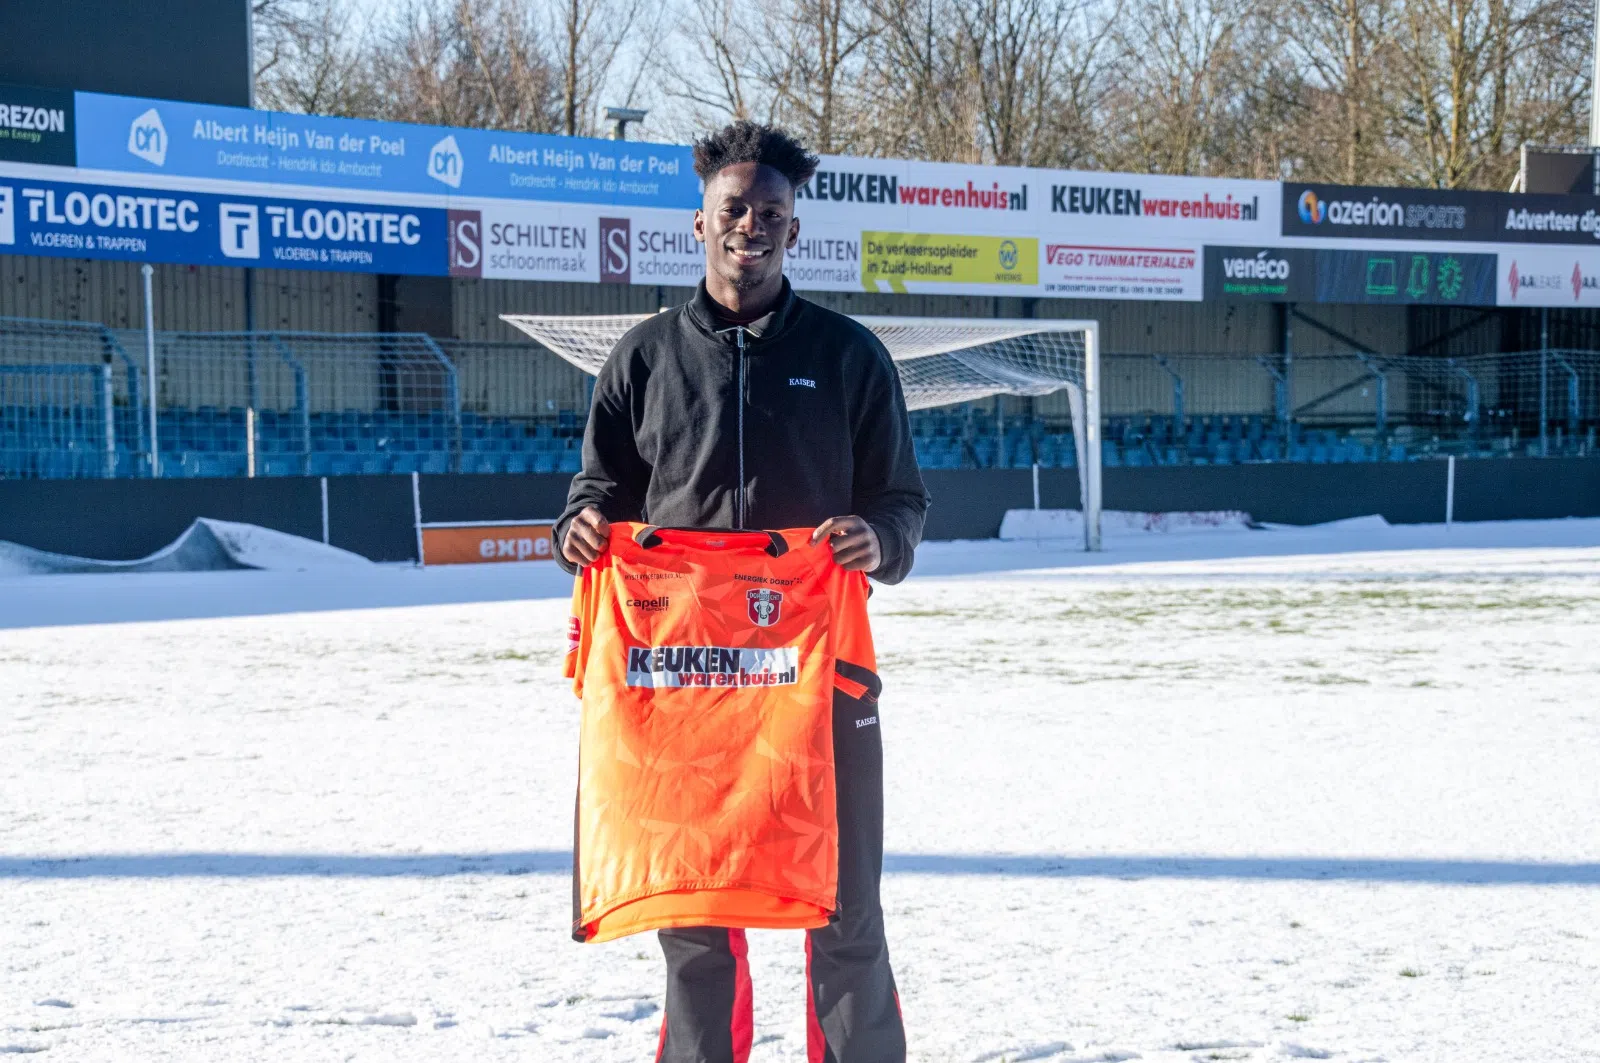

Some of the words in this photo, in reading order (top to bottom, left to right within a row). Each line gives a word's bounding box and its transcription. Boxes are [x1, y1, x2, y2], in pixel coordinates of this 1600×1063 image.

[11, 129, 42, 143] Energy
[192, 119, 249, 143] Albert
[253, 125, 299, 151] Heijn
[304, 130, 335, 150] Van
[338, 132, 366, 153] der
[370, 135, 405, 156] Poel
[217, 150, 269, 169] Dordrecht
[278, 156, 317, 173] Hendrik
[338, 160, 382, 178] Ambacht
[488, 144, 539, 166] Albert
[543, 148, 584, 172] Heijn
[588, 152, 616, 170] Van
[619, 154, 643, 173] der
[648, 157, 679, 176] Poel
[510, 173, 556, 189] Dordrecht
[564, 175, 600, 191] Hendrik
[618, 179, 659, 195] Ambacht
[22, 187, 200, 233] FLOORTEC
[1328, 197, 1403, 227] azerion
[1405, 204, 1466, 229] SPORTS
[1505, 208, 1579, 231] Adverteer
[265, 206, 420, 245] FLOORTEC
[490, 223, 587, 250] SCHILTEN
[30, 232, 83, 249] VLOEREN
[85, 235, 95, 250] &
[97, 235, 147, 252] TRAPPEN
[456, 220, 480, 268] S
[607, 228, 629, 275] S
[638, 231, 705, 255] SCHILT
[867, 241, 883, 255] De
[885, 241, 978, 261] verkeersopleider
[273, 247, 319, 262] VLOEREN
[320, 250, 328, 262] &
[330, 250, 373, 264] TRAPPEN
[490, 250, 587, 273] schoonmaak
[638, 257, 703, 276] schoonm
[1046, 245, 1084, 266] VEGO
[1088, 253, 1196, 270] TUINMATERIALEN
[1223, 250, 1290, 280] venéco
[784, 262, 858, 282] hoonmaak
[867, 259, 879, 272] in
[881, 260, 953, 276] Zuid-Holland
[789, 377, 816, 389] KAISER
[734, 573, 768, 584] ENERGIEK
[769, 578, 794, 586] DORDT
[626, 597, 669, 611] capelli
[629, 647, 741, 673] KEUKEN
[855, 716, 877, 729] KAISER
